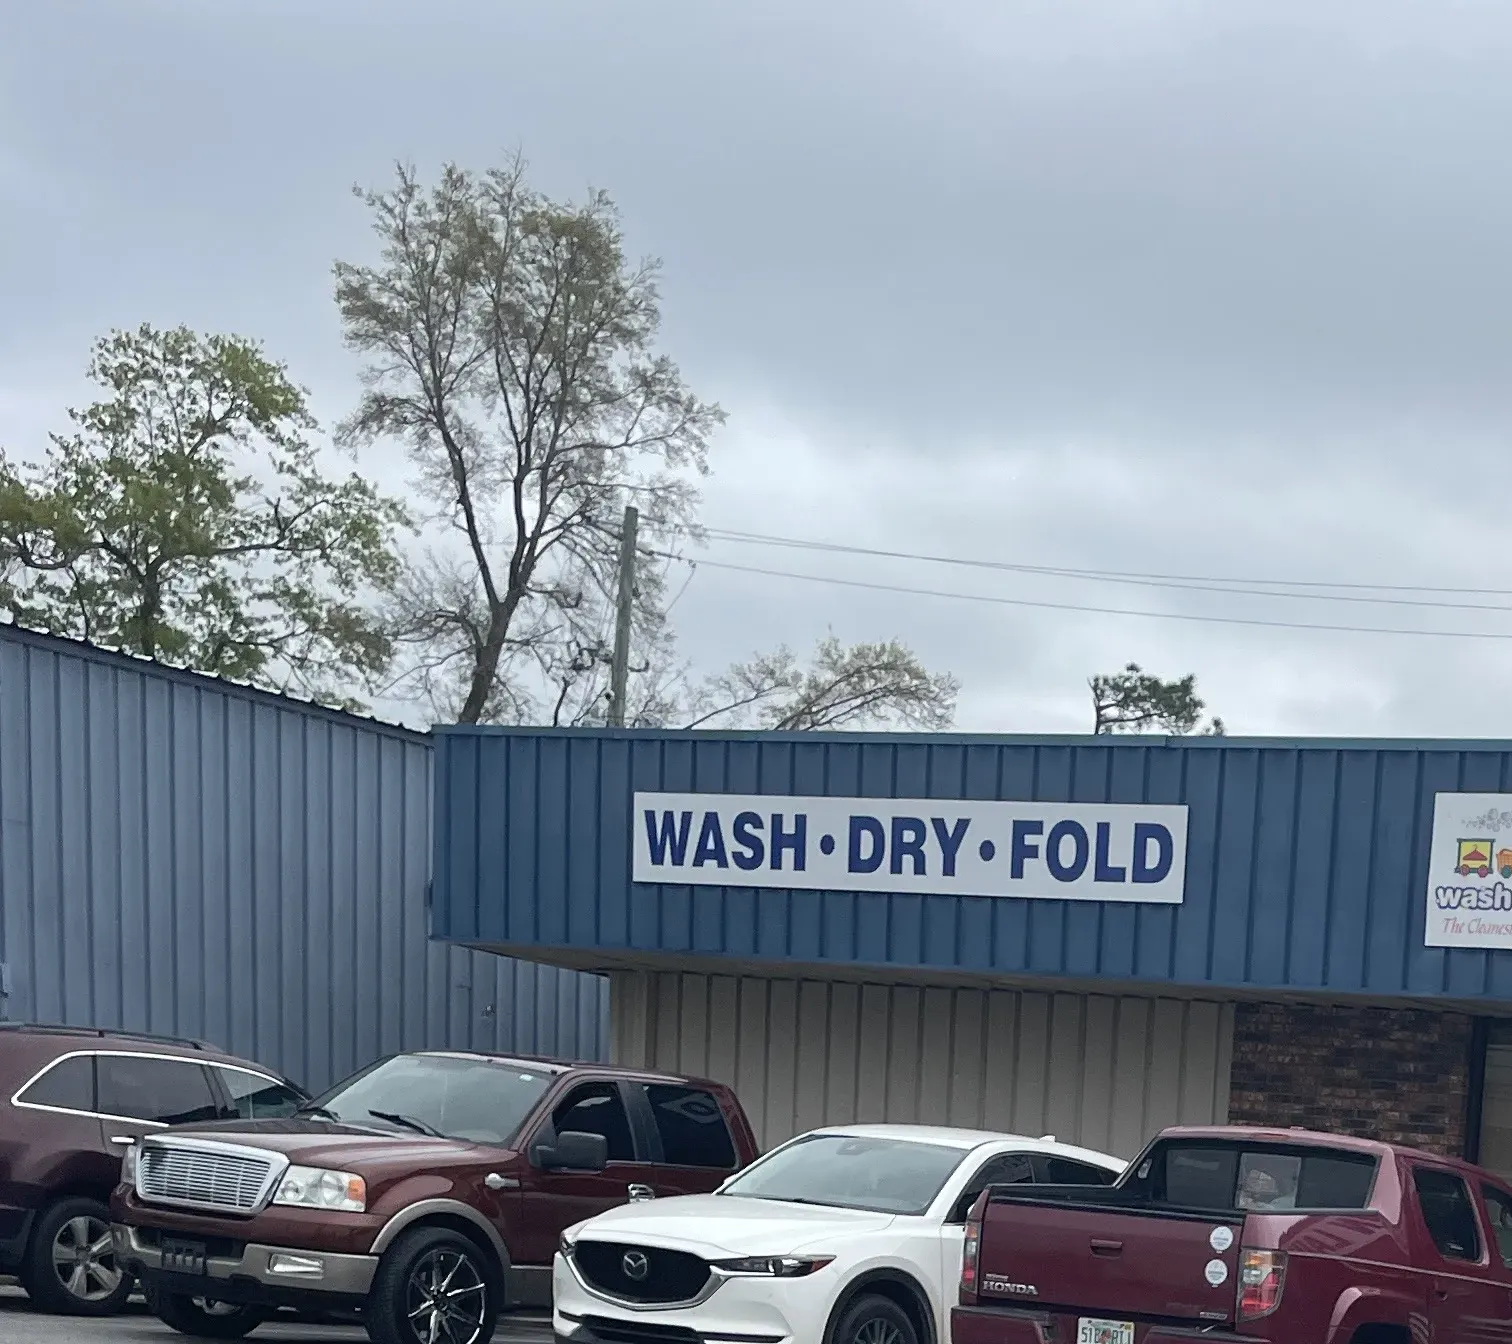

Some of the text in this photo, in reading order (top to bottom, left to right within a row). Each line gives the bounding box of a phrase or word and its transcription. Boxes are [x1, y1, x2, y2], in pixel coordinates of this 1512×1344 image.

[644, 809, 1174, 884] WASH DRY FOLD
[1435, 882, 1512, 911] wash
[1442, 917, 1463, 934] The
[983, 1280, 1039, 1295] HONDA
